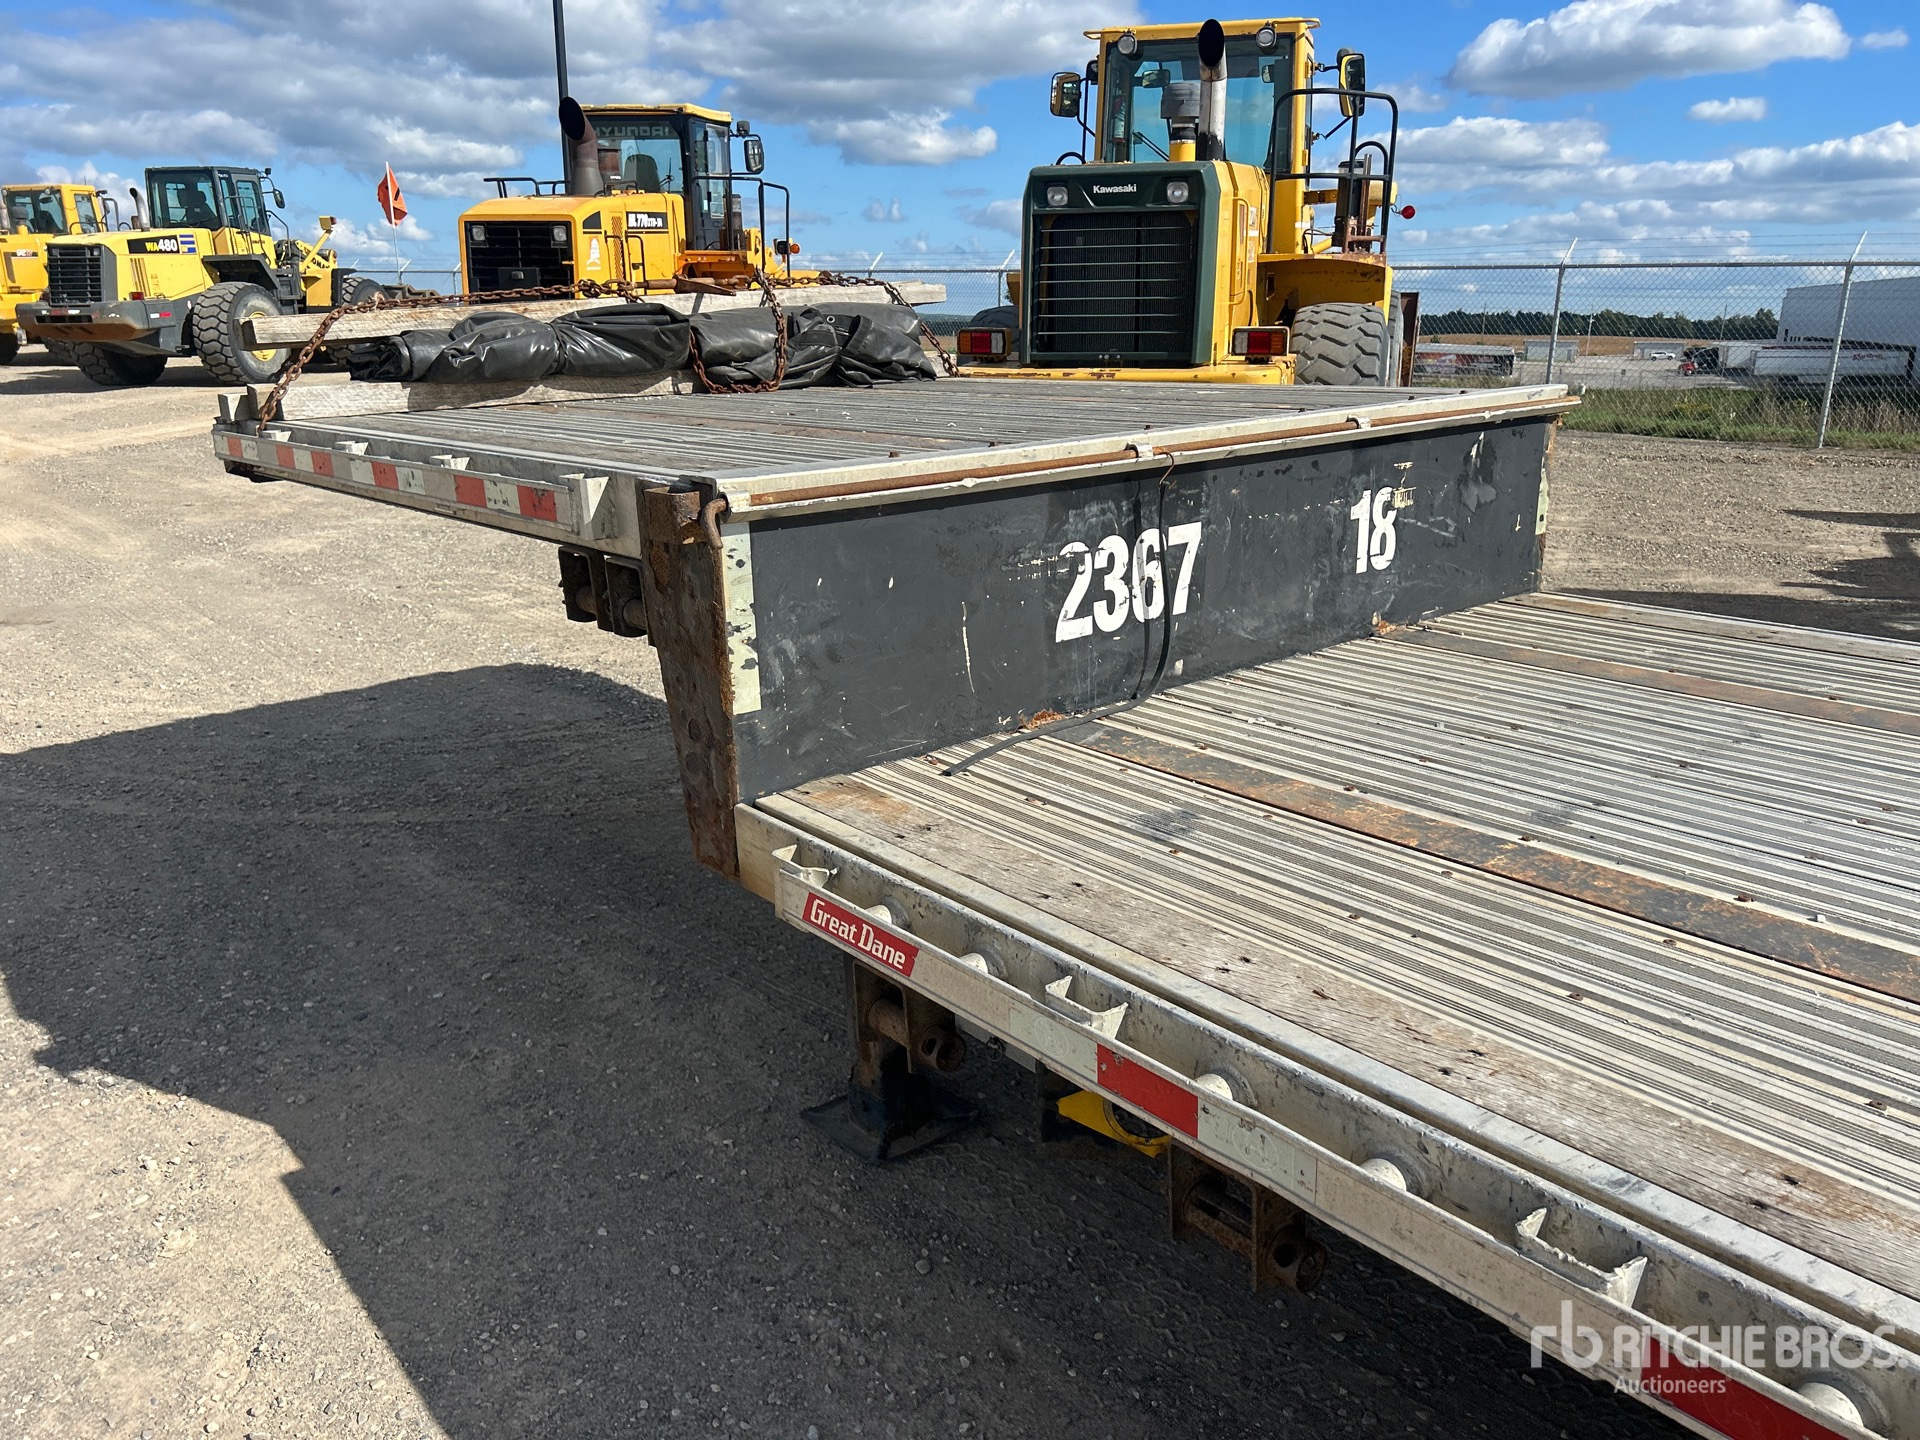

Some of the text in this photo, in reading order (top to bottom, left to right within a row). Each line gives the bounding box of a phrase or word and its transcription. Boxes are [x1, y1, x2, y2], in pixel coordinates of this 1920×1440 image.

[1093, 184, 1137, 194] Kawasaki
[145, 239, 178, 252] WA480
[1350, 486, 1398, 575] 18
[1055, 521, 1202, 643] 2367
[810, 899, 906, 970] Great Dane
